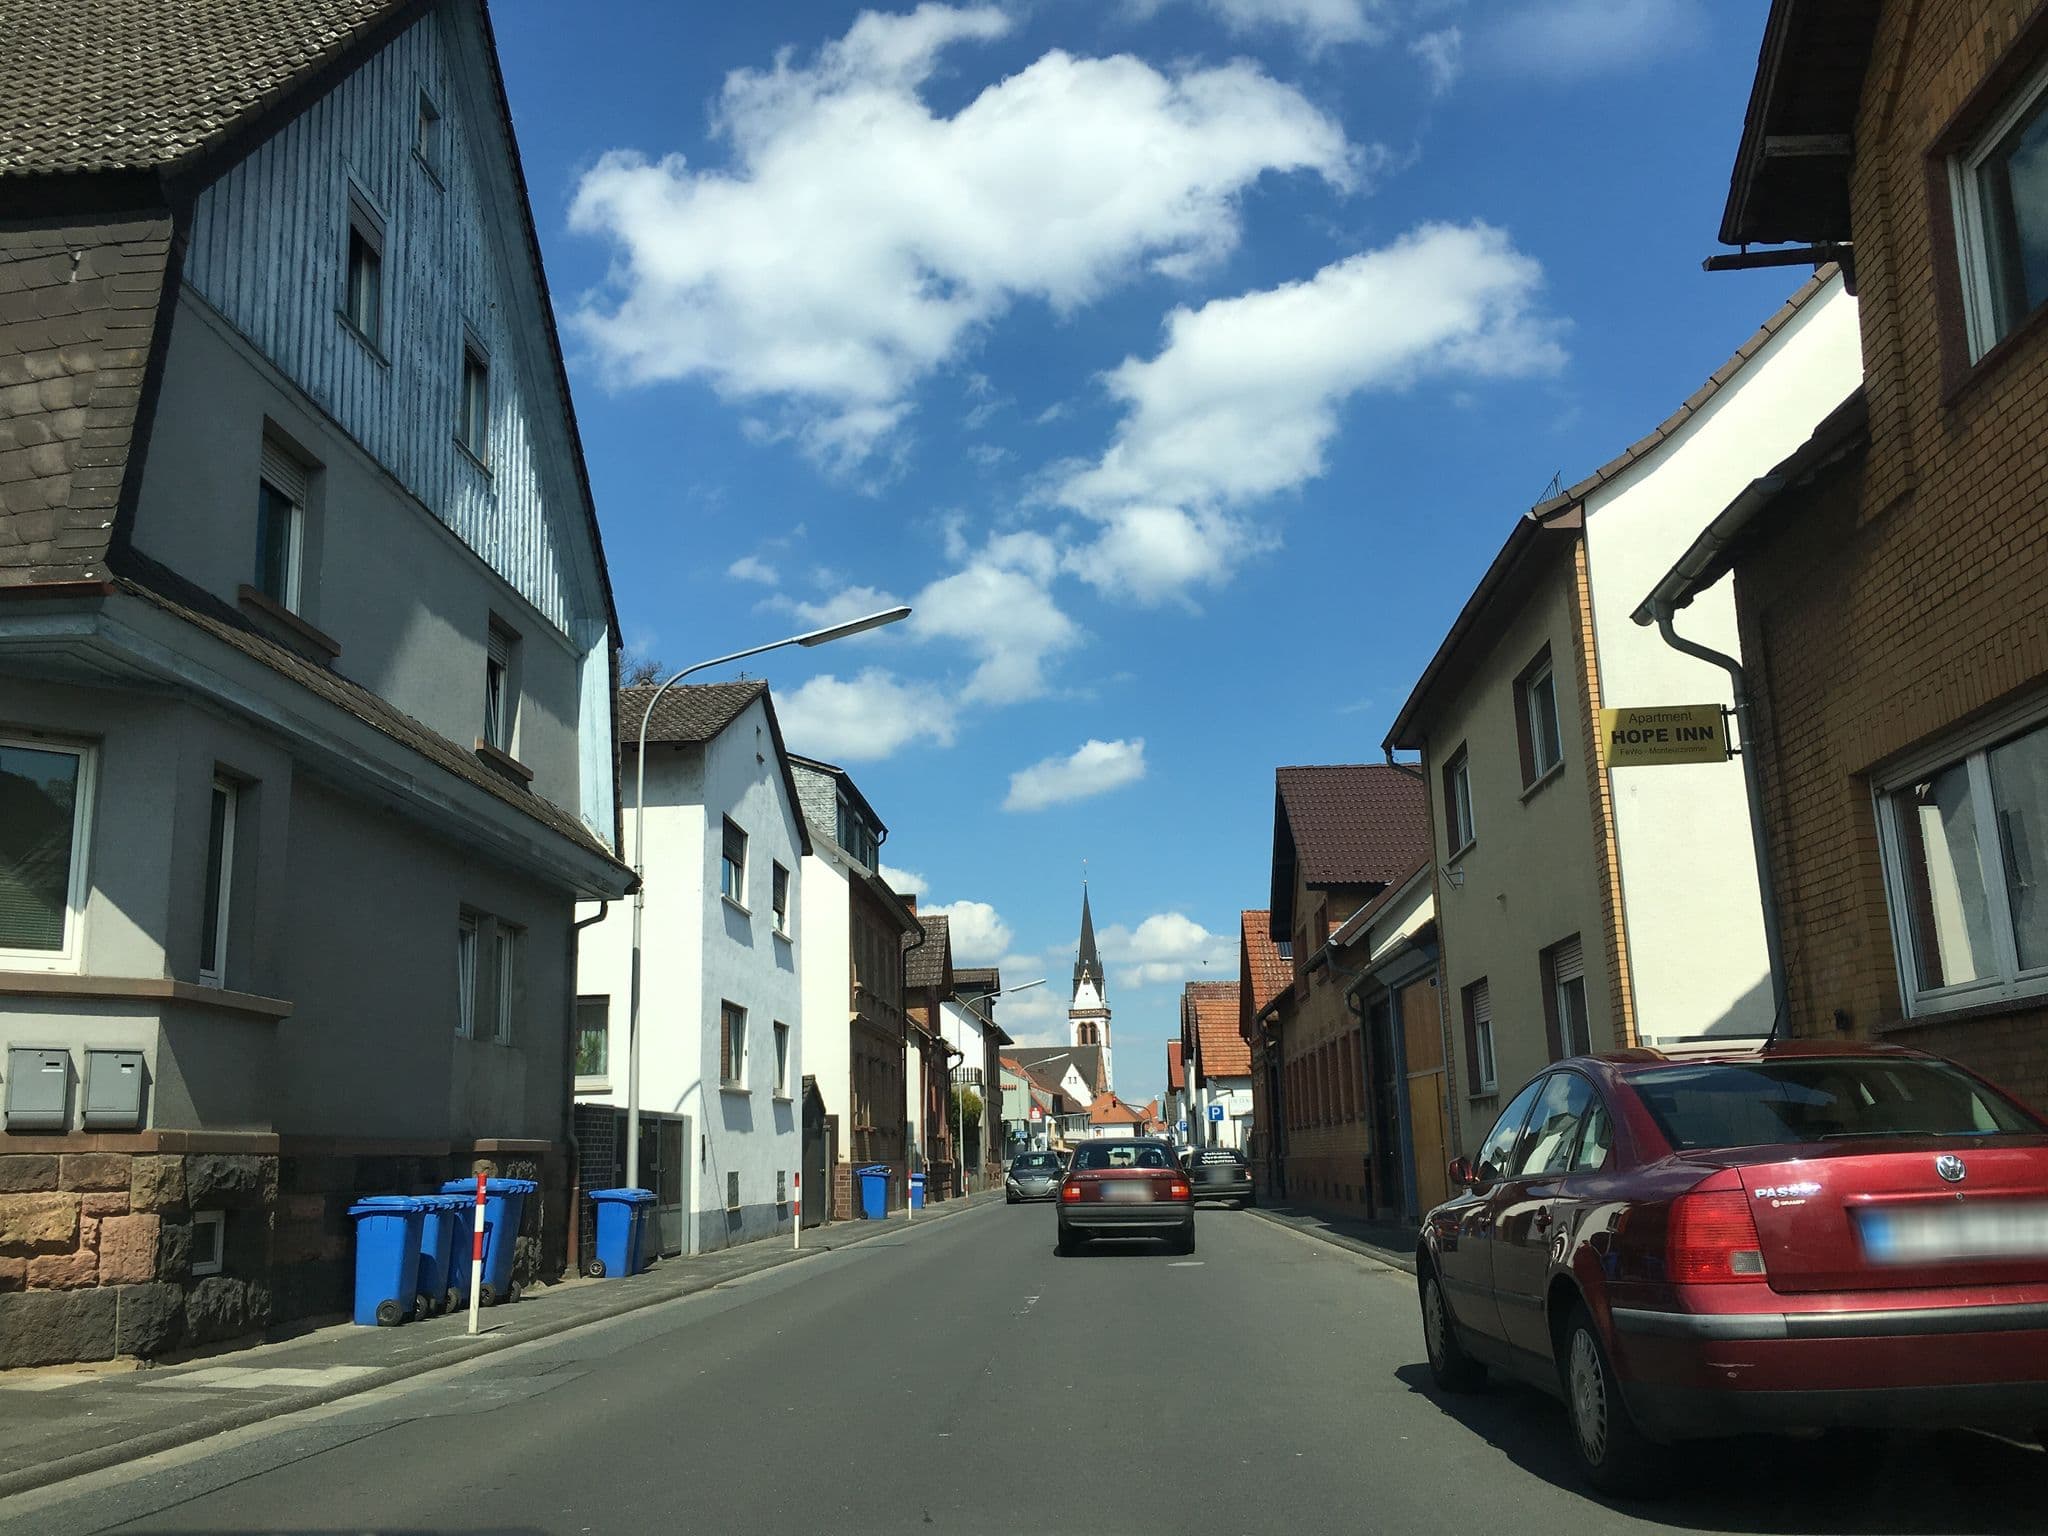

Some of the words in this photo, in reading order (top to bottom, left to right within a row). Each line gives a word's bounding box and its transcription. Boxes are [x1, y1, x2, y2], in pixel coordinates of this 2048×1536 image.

[1628, 711, 1692, 725] Apartment
[1611, 728, 1669, 745] HOPE
[1676, 726, 1714, 741] INN
[1211, 1107, 1221, 1119] P
[1754, 1182, 1822, 1199] PASS
